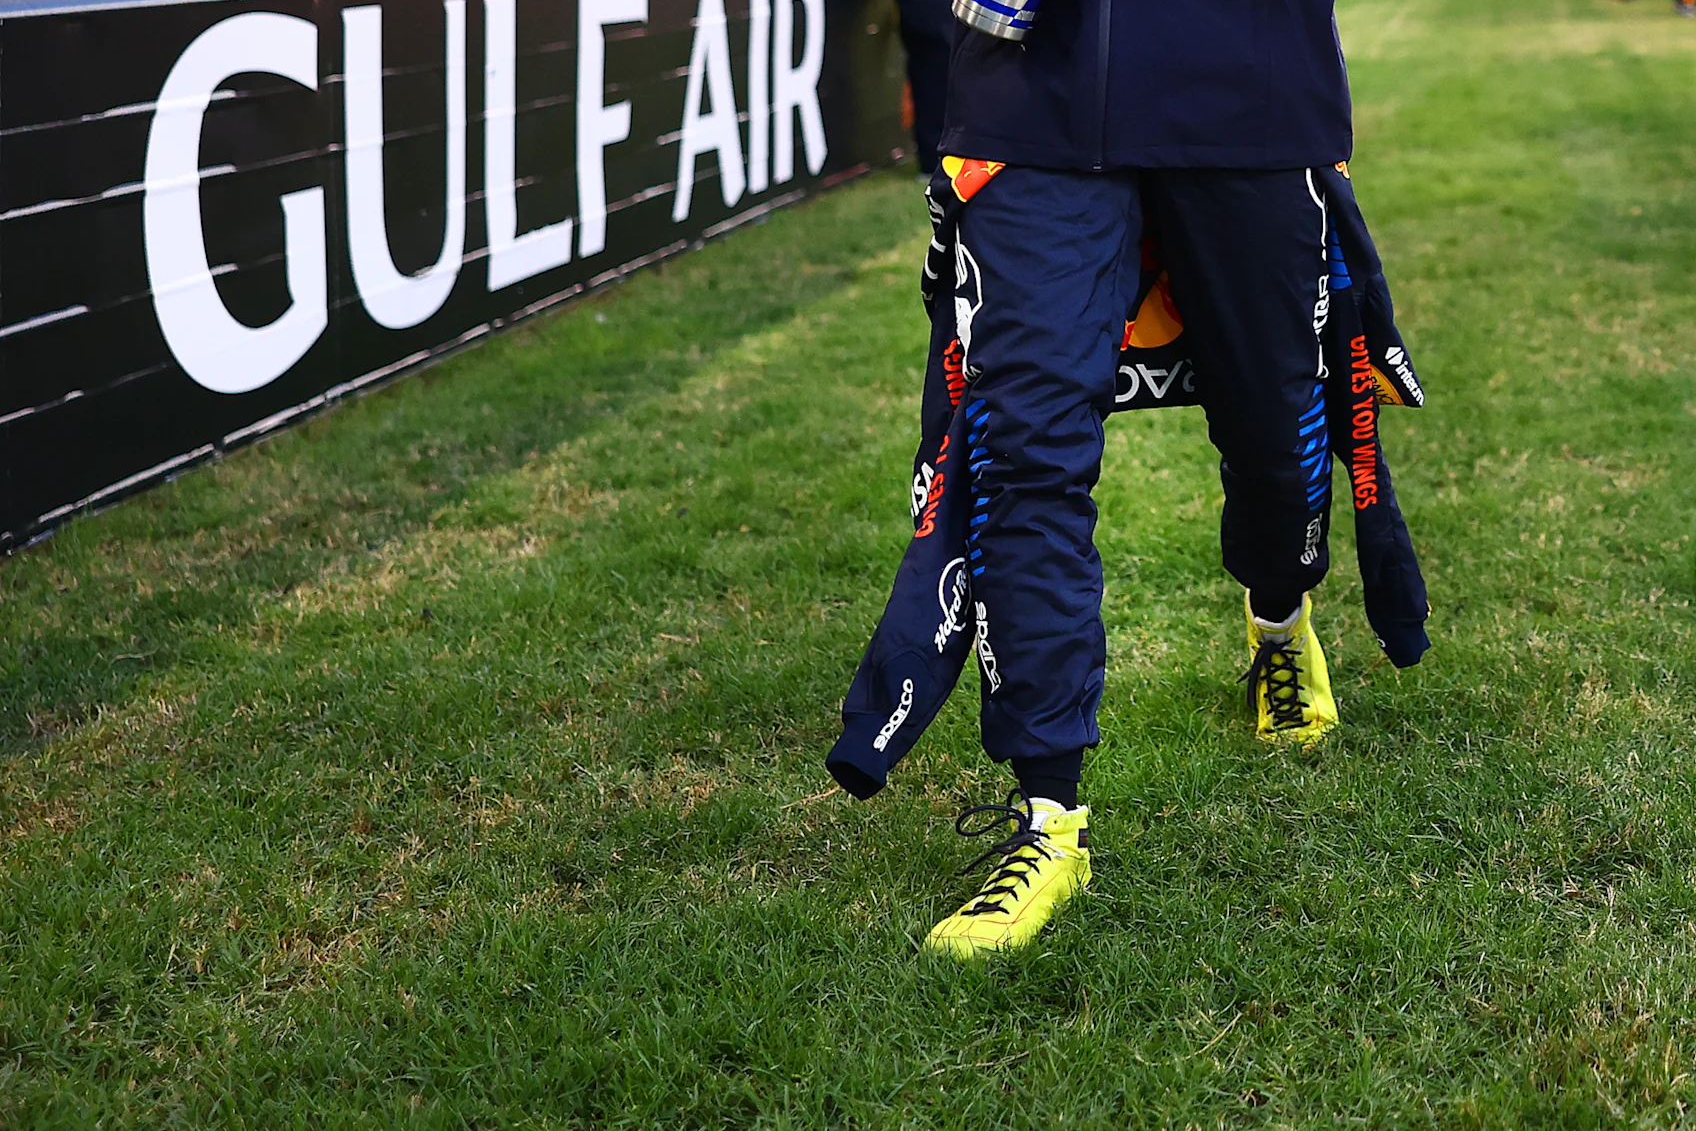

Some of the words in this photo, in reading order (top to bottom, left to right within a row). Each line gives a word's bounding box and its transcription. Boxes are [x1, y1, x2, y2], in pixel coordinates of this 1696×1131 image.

[1350, 335, 1373, 394] GIVES
[1352, 396, 1375, 440] YOU
[1352, 442, 1379, 510] WINGS
[934, 585, 961, 654] Hard
[873, 678, 914, 752] sparco
